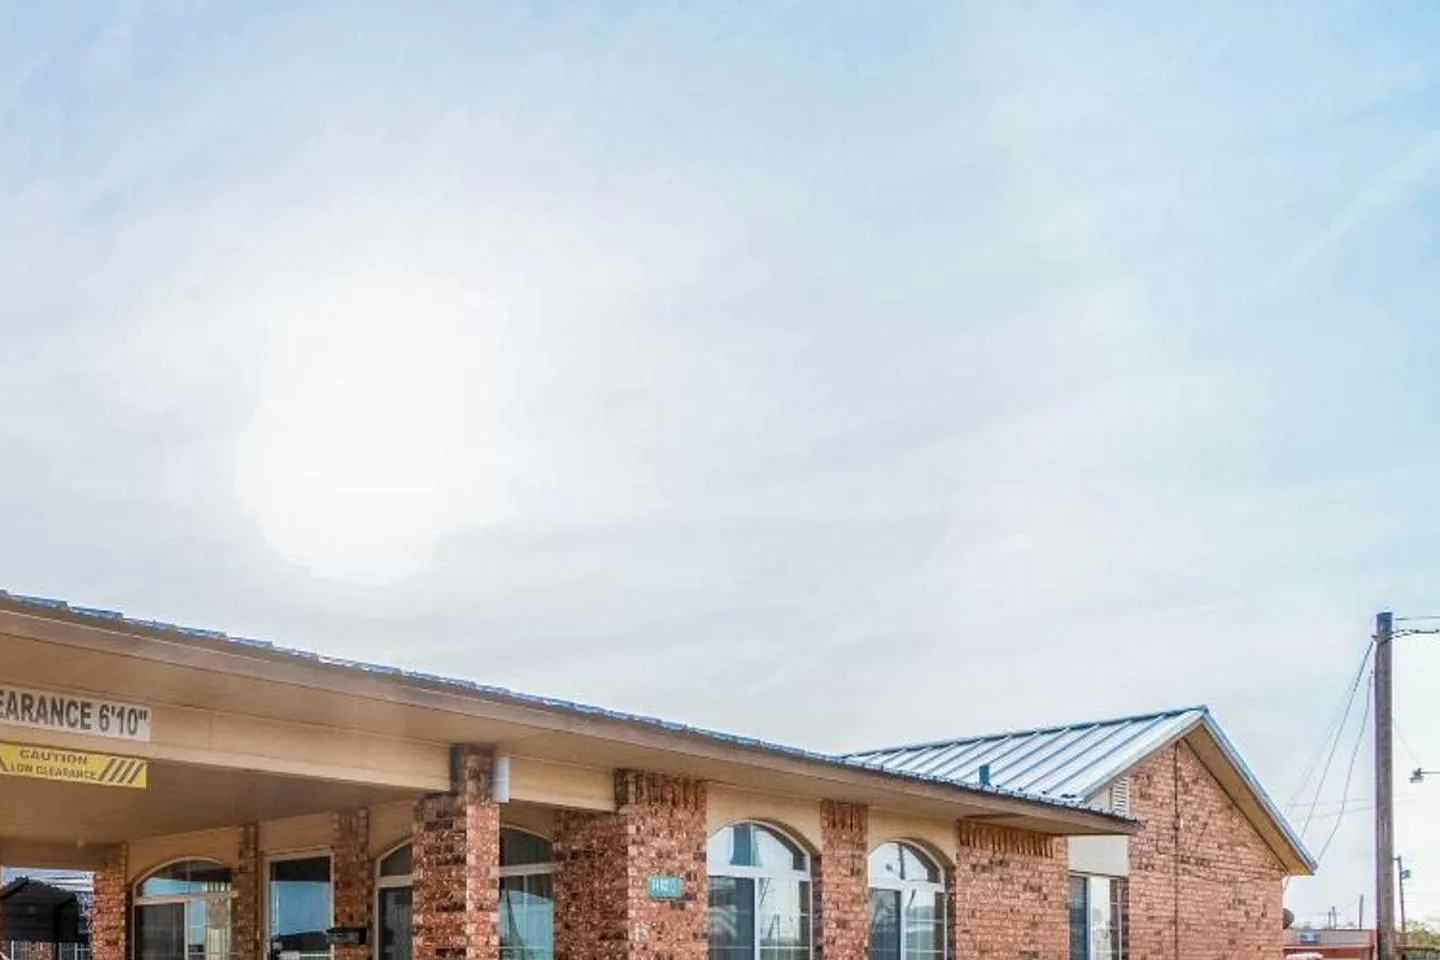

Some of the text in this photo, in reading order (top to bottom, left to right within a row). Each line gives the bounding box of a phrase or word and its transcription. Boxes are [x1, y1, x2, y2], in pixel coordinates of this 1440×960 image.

[98, 704, 147, 736] 6'10"
[19, 749, 88, 765] CAUTION
[10, 763, 97, 781] LOW CLEARANCE
